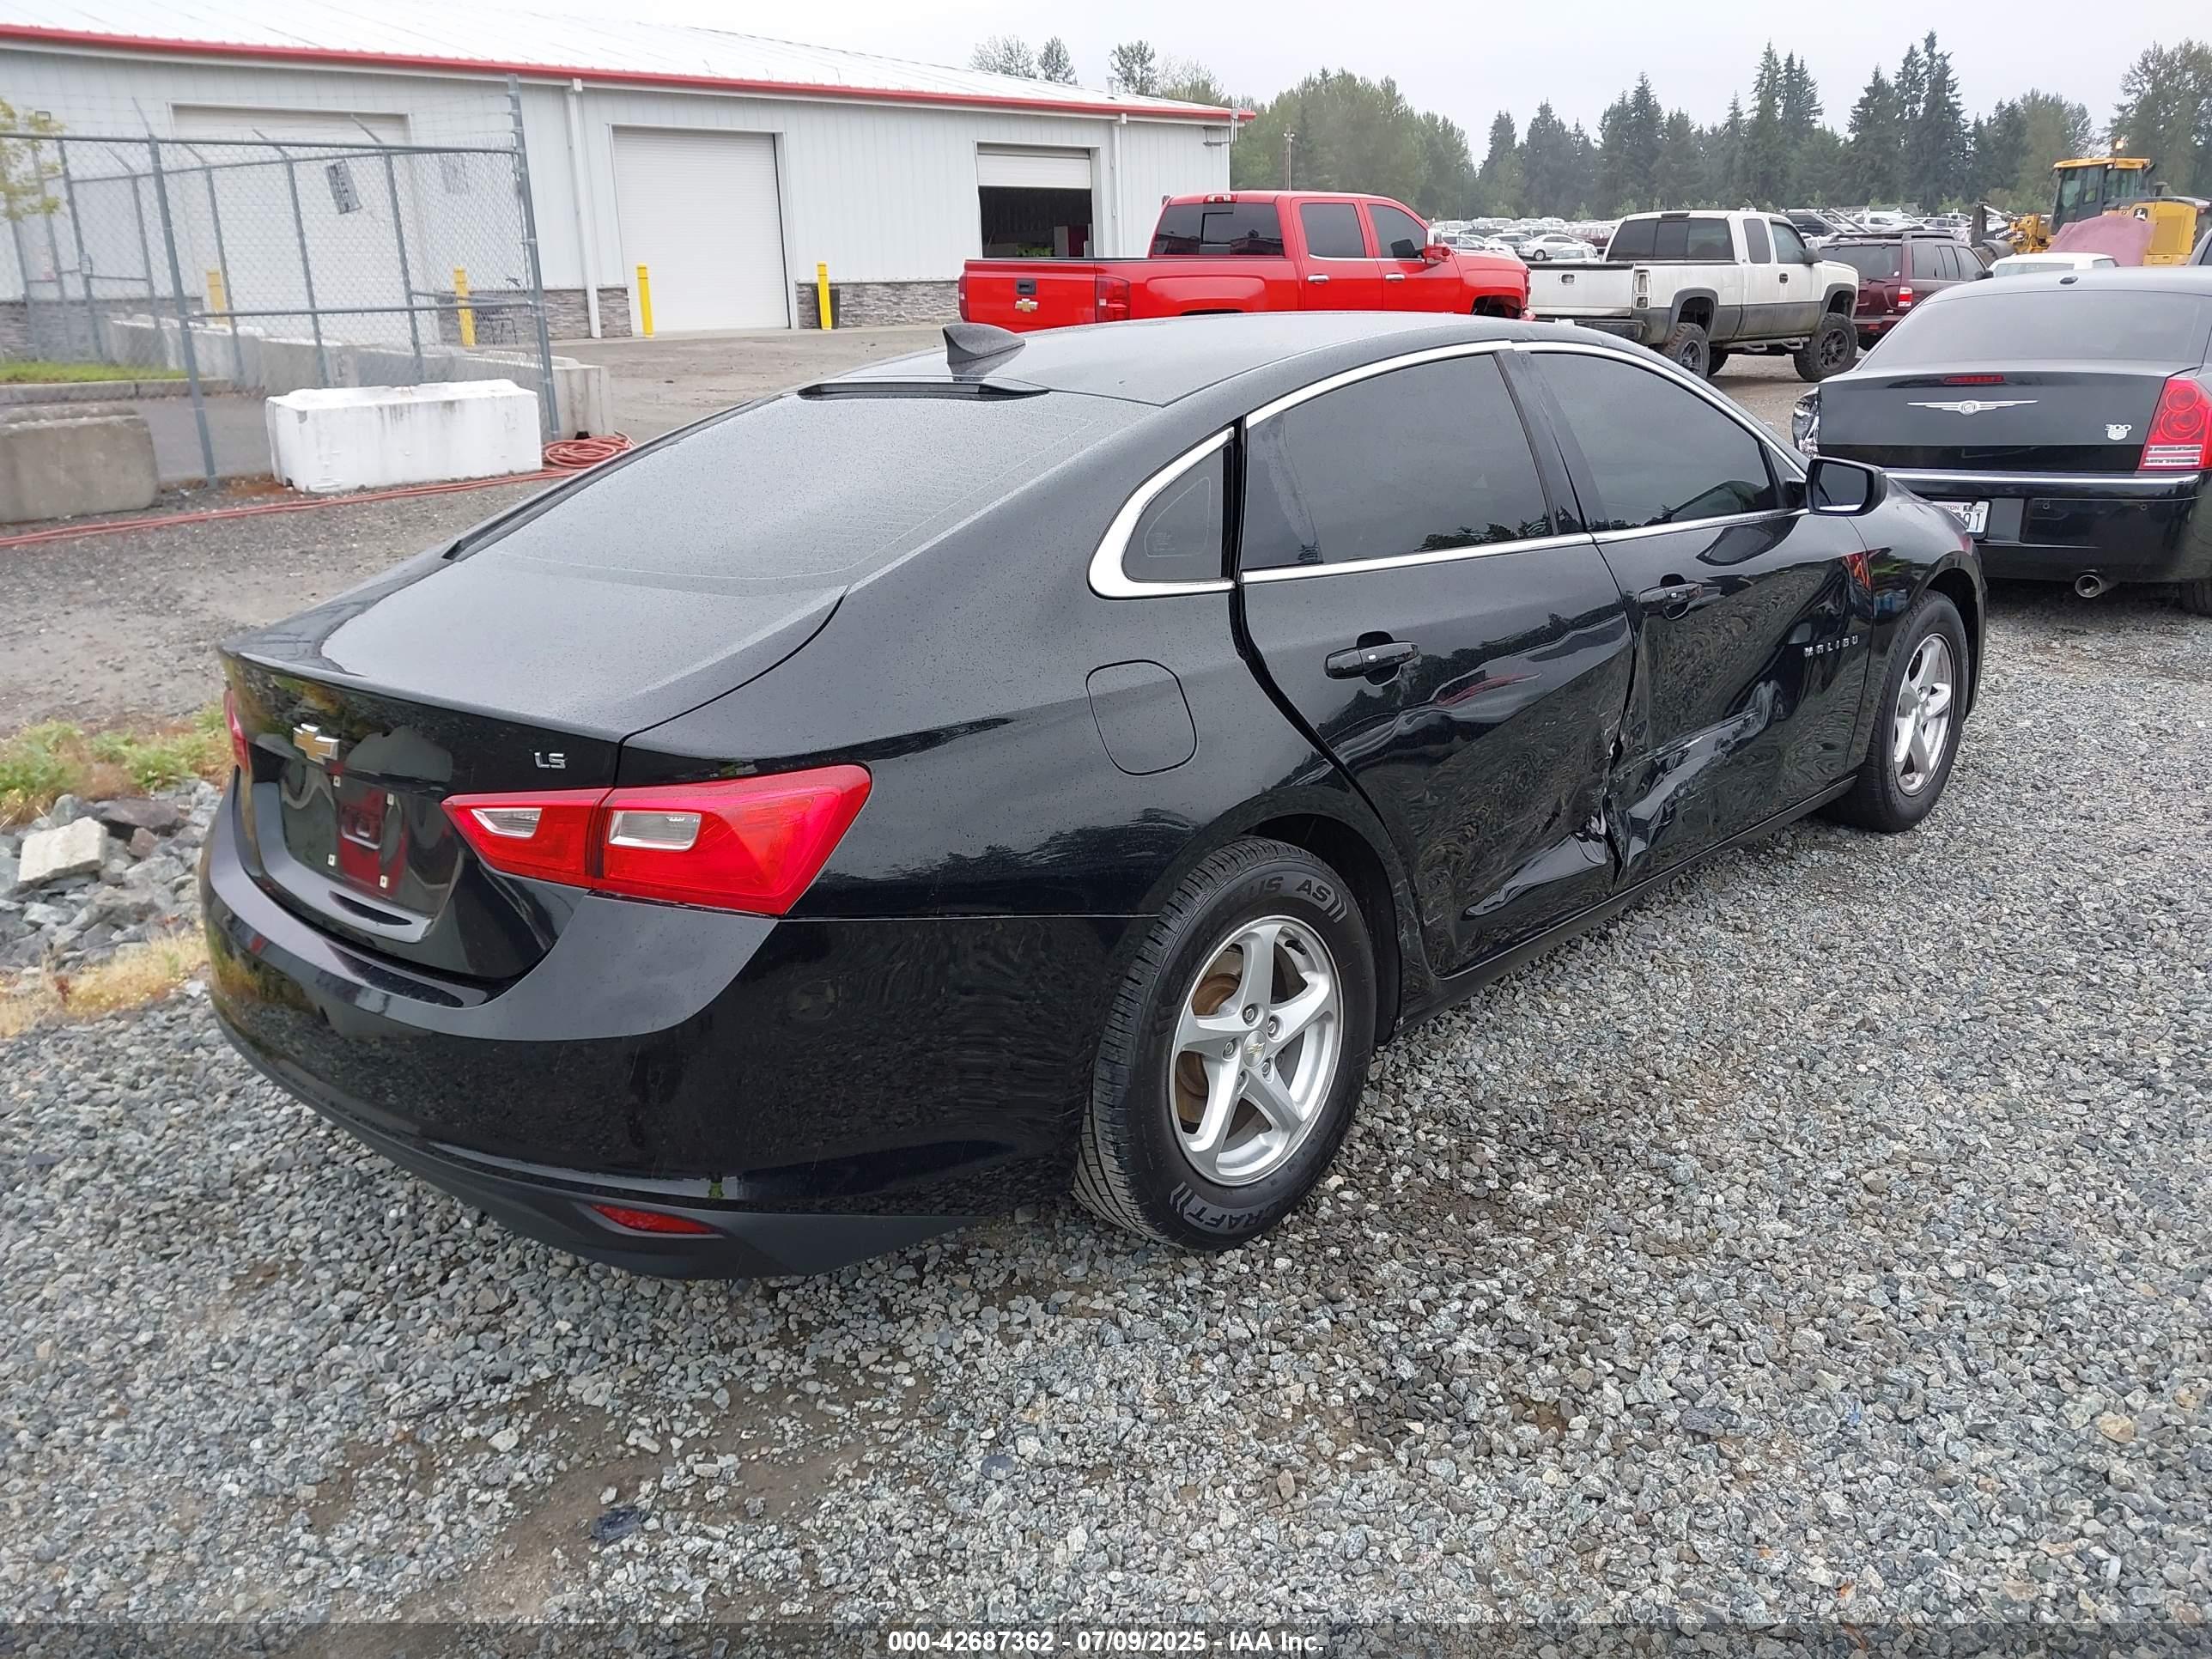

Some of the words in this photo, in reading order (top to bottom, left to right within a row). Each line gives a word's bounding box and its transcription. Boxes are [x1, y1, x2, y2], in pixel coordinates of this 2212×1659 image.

[1804, 635, 1858, 658] MALIBU
[534, 752, 566, 769] LS
[1296, 878, 1331, 902] AS
